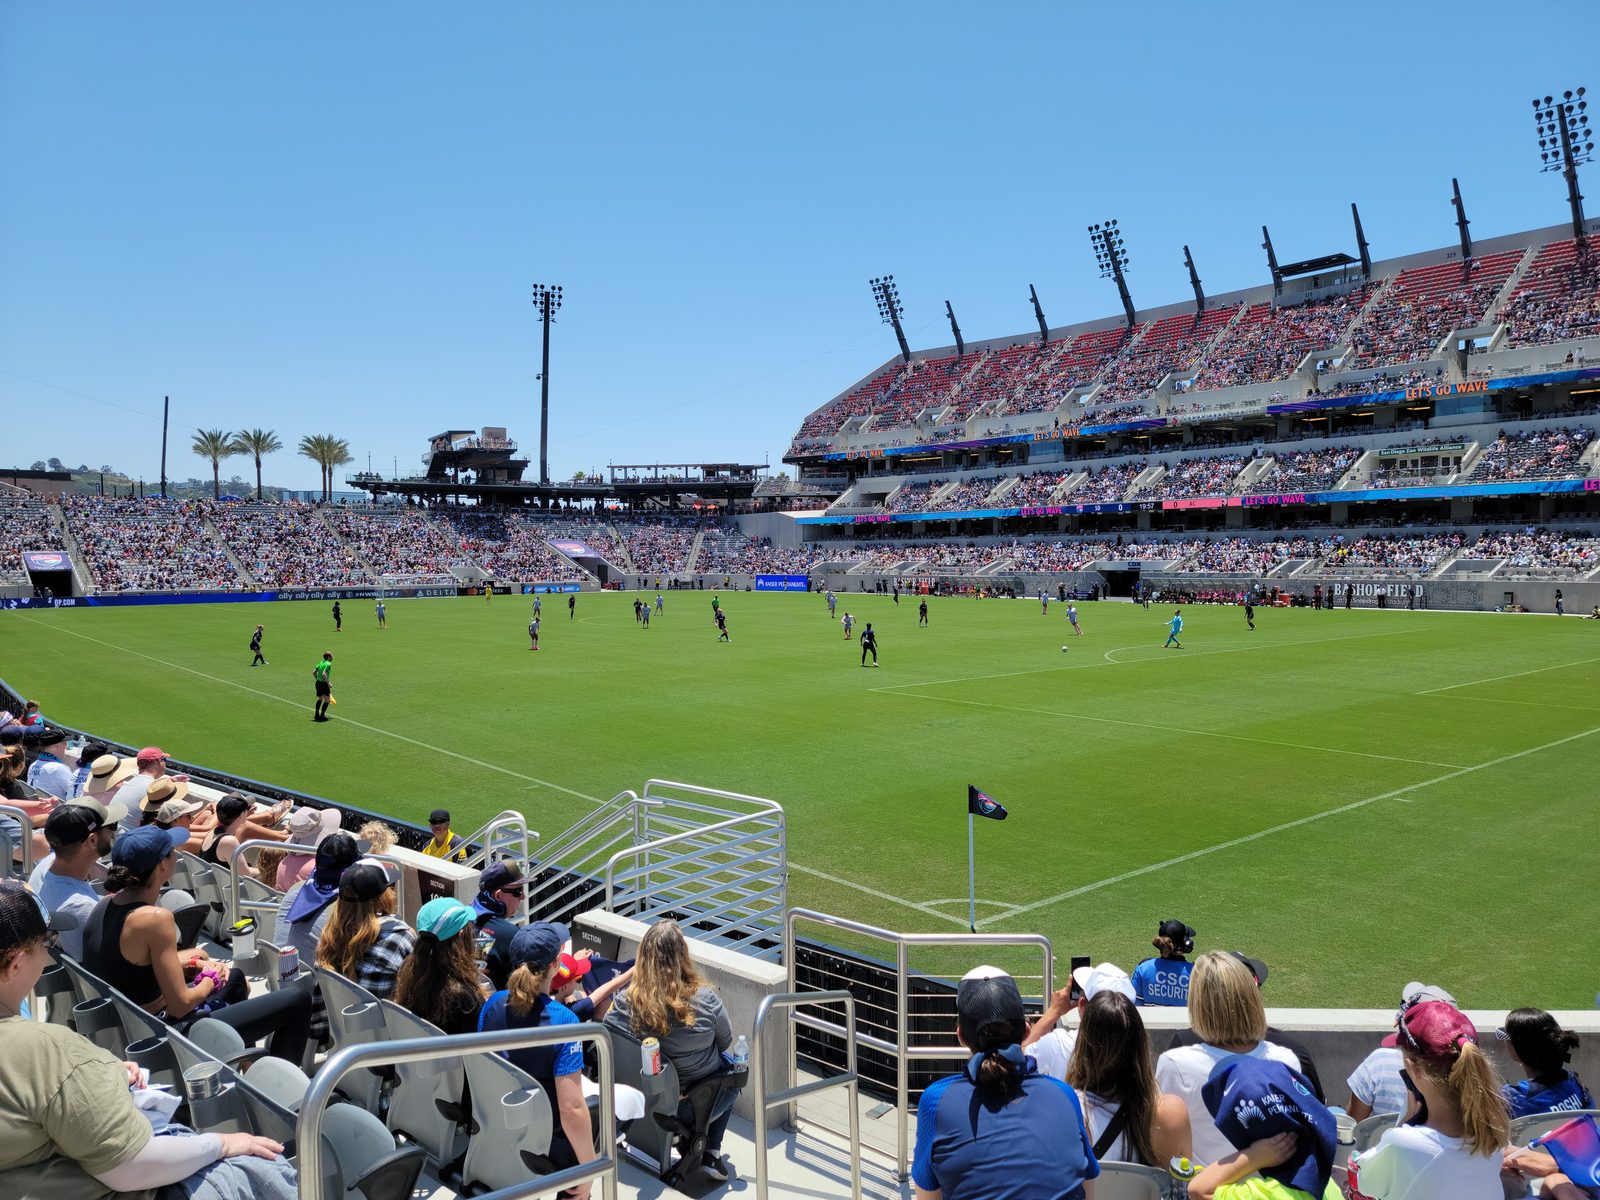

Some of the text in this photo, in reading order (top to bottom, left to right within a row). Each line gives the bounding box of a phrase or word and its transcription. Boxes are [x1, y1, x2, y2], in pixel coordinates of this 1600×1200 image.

[1406, 381, 1488, 399] LET'S GO WAVE
[1034, 428, 1080, 440] LET'S GO WAVE
[1245, 494, 1305, 505] LET'S GO WAVE
[279, 590, 293, 600] ally
[296, 590, 309, 600] ally
[311, 590, 324, 599] ally
[327, 590, 341, 598] ally
[1387, 584, 1424, 597] FIED
[430, 880, 445, 889] SECTION
[582, 932, 602, 944] SECTION
[1155, 971, 1189, 988] CSC
[1148, 984, 1188, 1000] SECURIT
